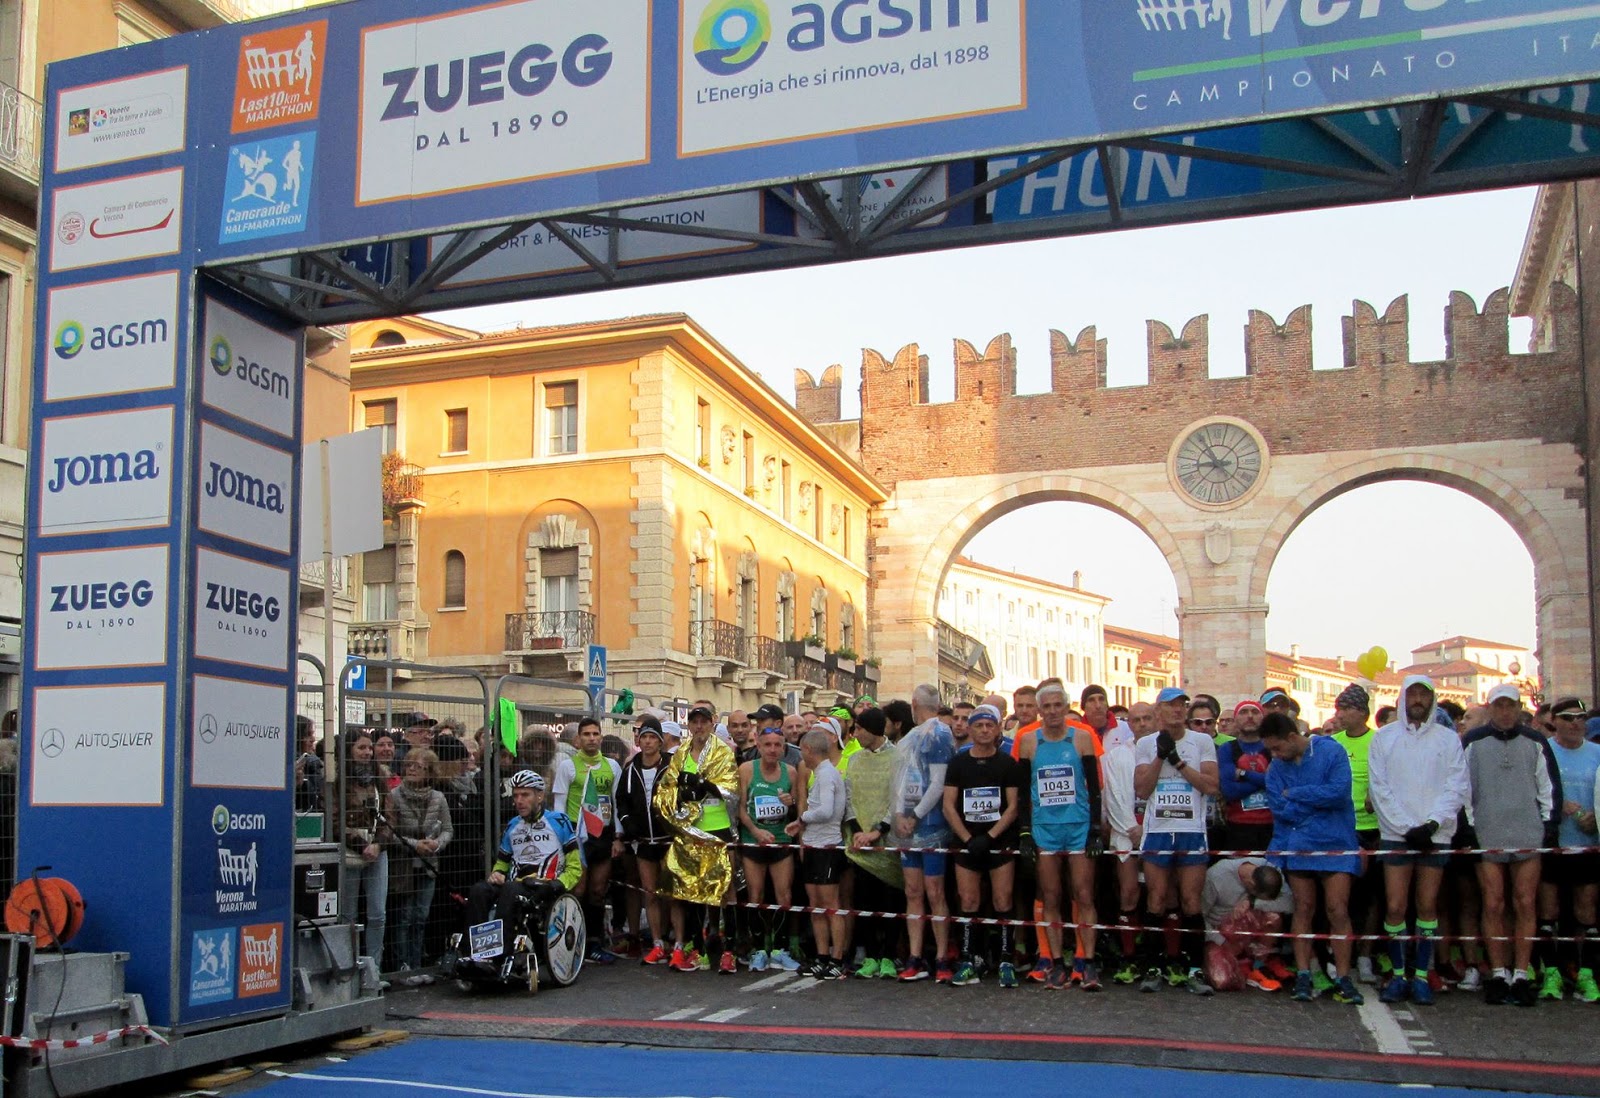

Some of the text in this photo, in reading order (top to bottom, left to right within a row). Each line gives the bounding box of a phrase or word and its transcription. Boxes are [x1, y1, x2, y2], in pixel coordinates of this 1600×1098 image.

[778, 74, 809, 92] che
[813, 69, 827, 86] si
[832, 59, 905, 83] rinnova,
[910, 52, 939, 71] dal
[943, 45, 990, 66] 1898
[380, 33, 613, 122] ZUEGG
[1133, 51, 1455, 111] CAMPIONATO
[246, 101, 313, 124] MARATHON
[416, 110, 569, 151] DAL 1890
[103, 197, 168, 214] Camera di Commercio
[103, 213, 123, 222] Verona
[225, 215, 302, 235] HALFMARATHON
[533, 232, 543, 245] &
[50, 579, 154, 613] ZUEGG
[205, 582, 280, 622] ZUEGG
[67, 617, 135, 630] DAL 1890
[218, 620, 267, 638] DAL 1890
[305, 701, 337, 712] AGENZA
[224, 721, 281, 739] AUTOSILVER
[74, 732, 153, 749] AUTOSILVER
[1044, 780, 1070, 791] 1043
[971, 800, 993, 810] 444
[1158, 794, 1191, 805] H1208
[759, 806, 785, 815] H1561
[216, 890, 244, 903] Verona
[219, 901, 257, 913] MARATHON
[324, 902, 330, 914] 4
[474, 933, 499, 948] 2792
[245, 979, 278, 991] MARATHON
